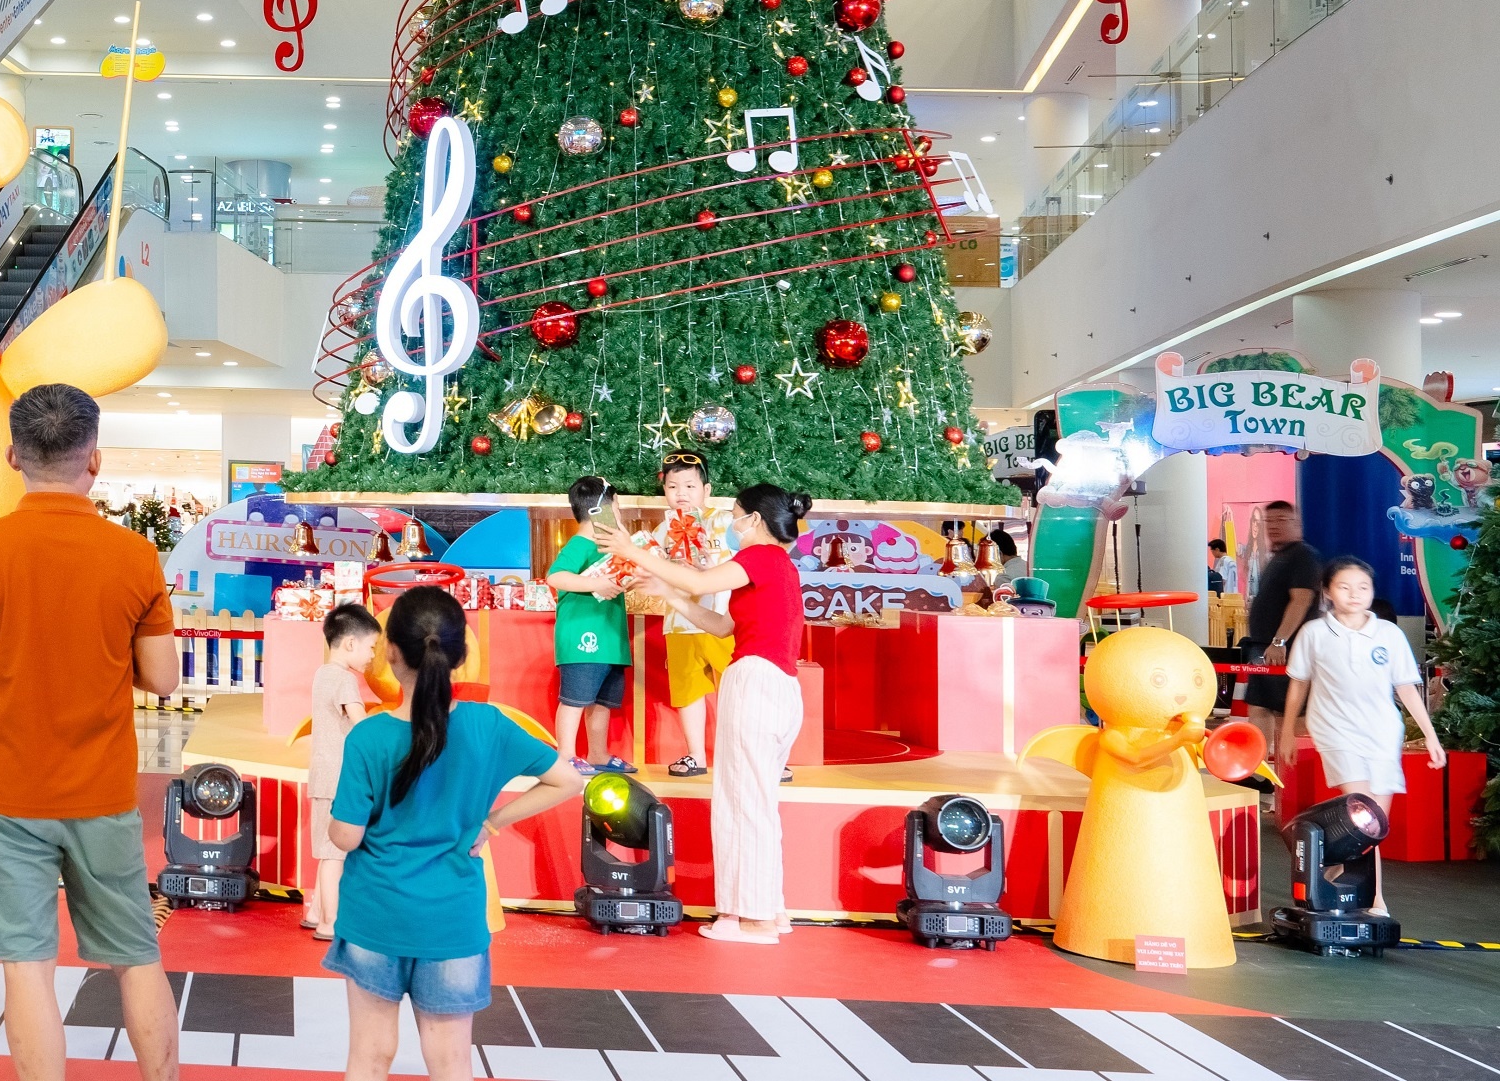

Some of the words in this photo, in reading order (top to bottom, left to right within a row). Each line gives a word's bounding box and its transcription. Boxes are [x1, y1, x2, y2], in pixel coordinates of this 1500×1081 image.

[142, 241, 150, 266] L2
[1165, 382, 1236, 413] BIG
[1250, 381, 1366, 421] BEAR
[984, 436, 1009, 457] BIG
[1015, 434, 1036, 450] BE
[194, 630, 222, 638] VivoCity
[1242, 665, 1270, 674] VivoCity
[202, 850, 220, 858] SVT
[612, 872, 628, 880] SVT
[947, 886, 966, 894] SVT
[1340, 894, 1354, 902] SVT
